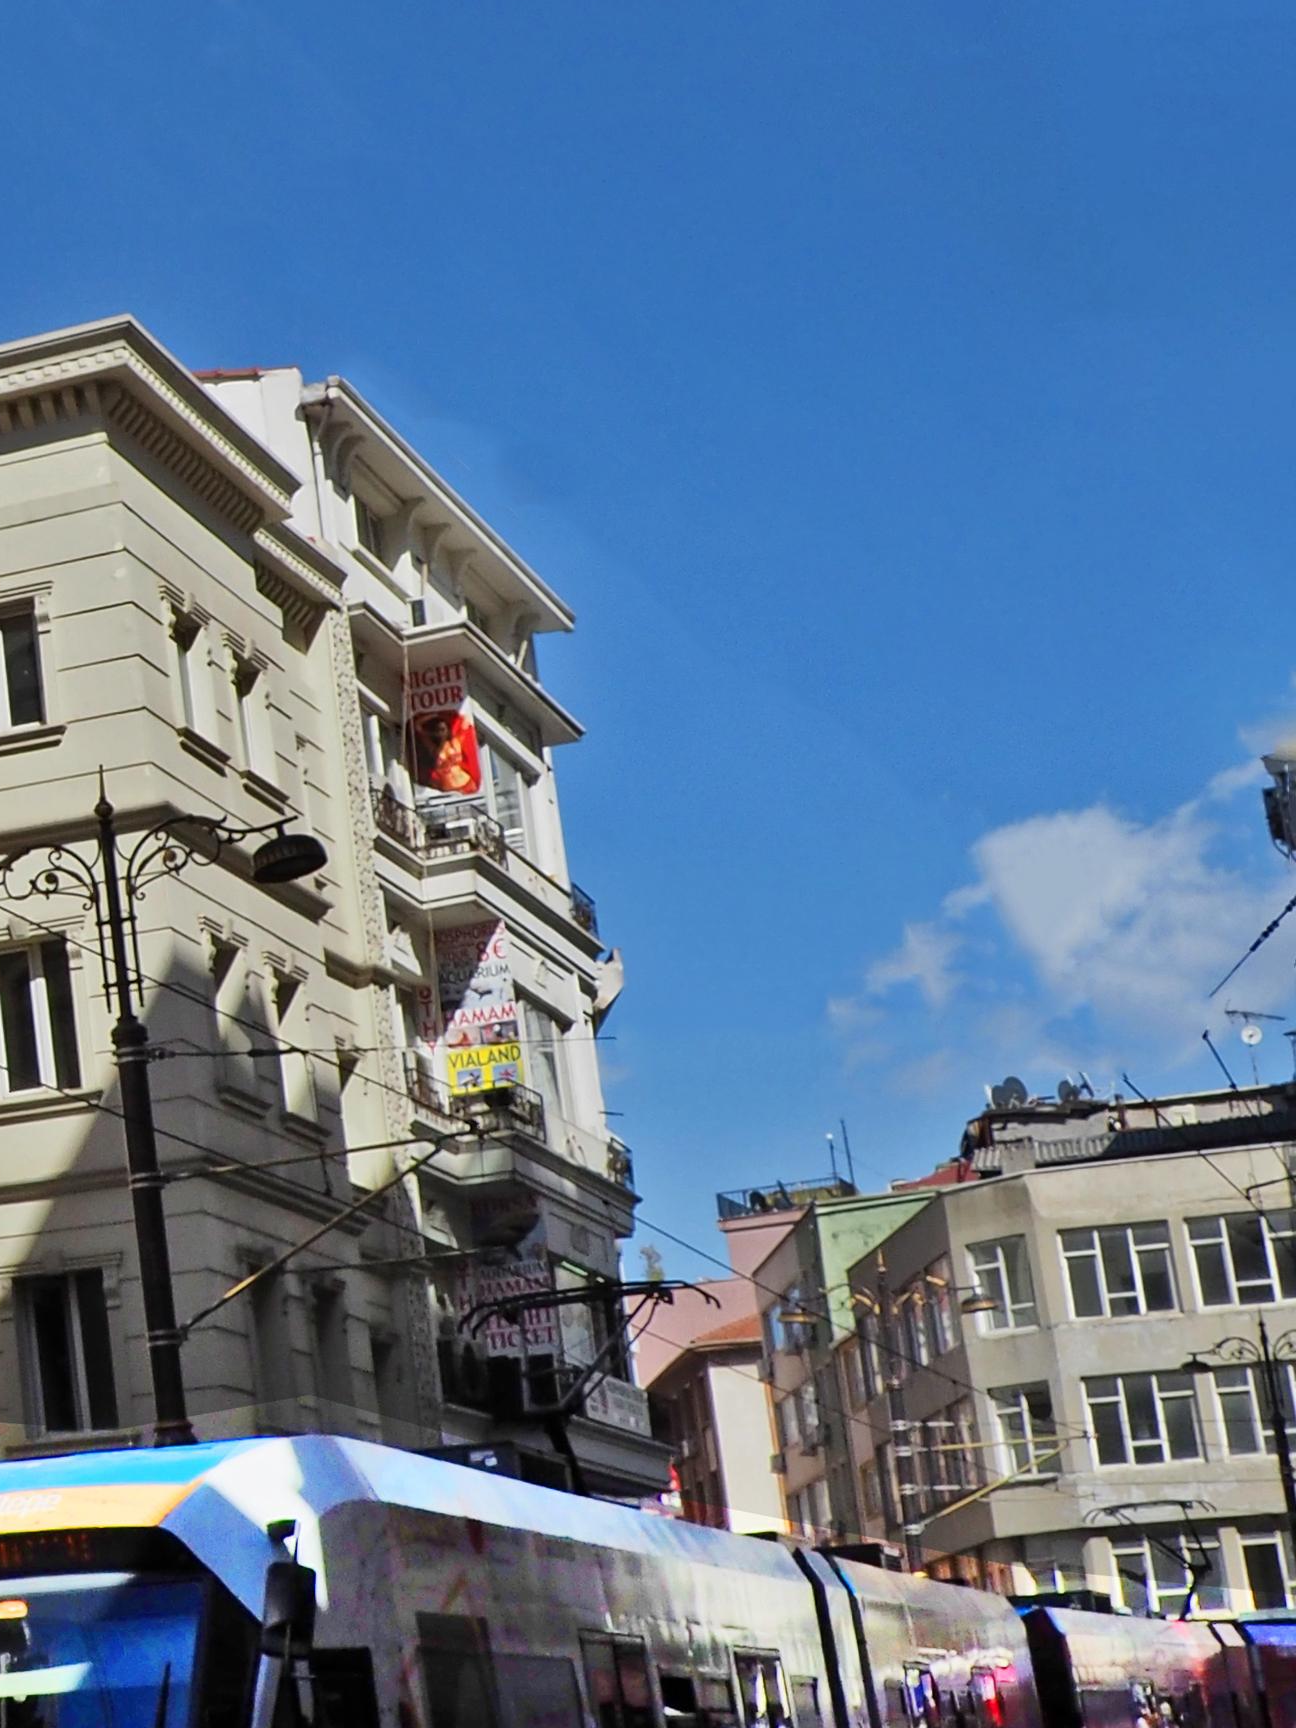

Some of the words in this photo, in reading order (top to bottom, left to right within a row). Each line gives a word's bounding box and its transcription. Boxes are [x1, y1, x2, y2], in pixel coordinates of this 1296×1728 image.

[400, 662, 463, 691] NIGHT
[406, 684, 464, 712] TOUR
[439, 964, 511, 986] AQUARIUM
[443, 1004, 518, 1030] HAMAM
[449, 1045, 521, 1070] VIALAND
[489, 1326, 553, 1350] TICKET
